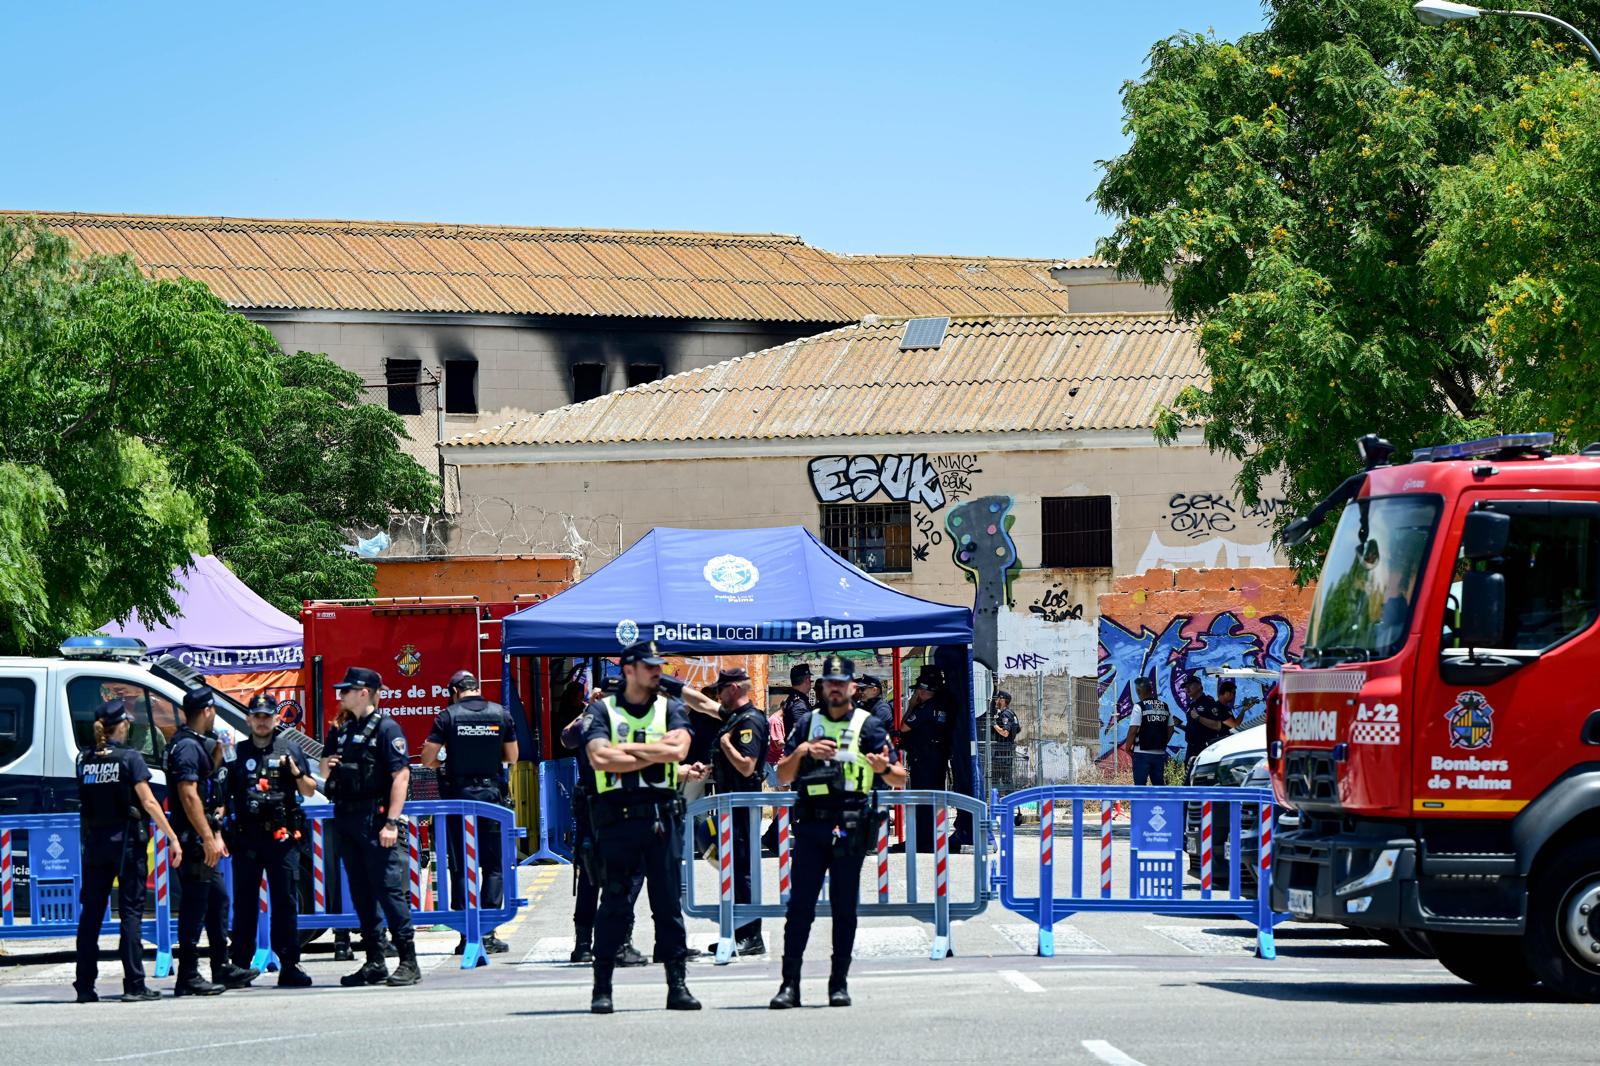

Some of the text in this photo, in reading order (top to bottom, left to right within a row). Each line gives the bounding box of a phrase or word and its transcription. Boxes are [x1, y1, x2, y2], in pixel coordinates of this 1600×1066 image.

[807, 453, 946, 513] ESUK
[913, 510, 943, 546] 420
[653, 620, 865, 640] Policia Local Palma
[178, 650, 232, 668] CIVIL
[236, 646, 305, 666] PALMA
[407, 685, 426, 698] de
[1356, 703, 1399, 722] A-22
[83, 762, 120, 775] POLICIA
[1431, 755, 1509, 771] Bombers
[95, 773, 120, 784] LOCAL
[1427, 774, 1512, 790] de Palma
